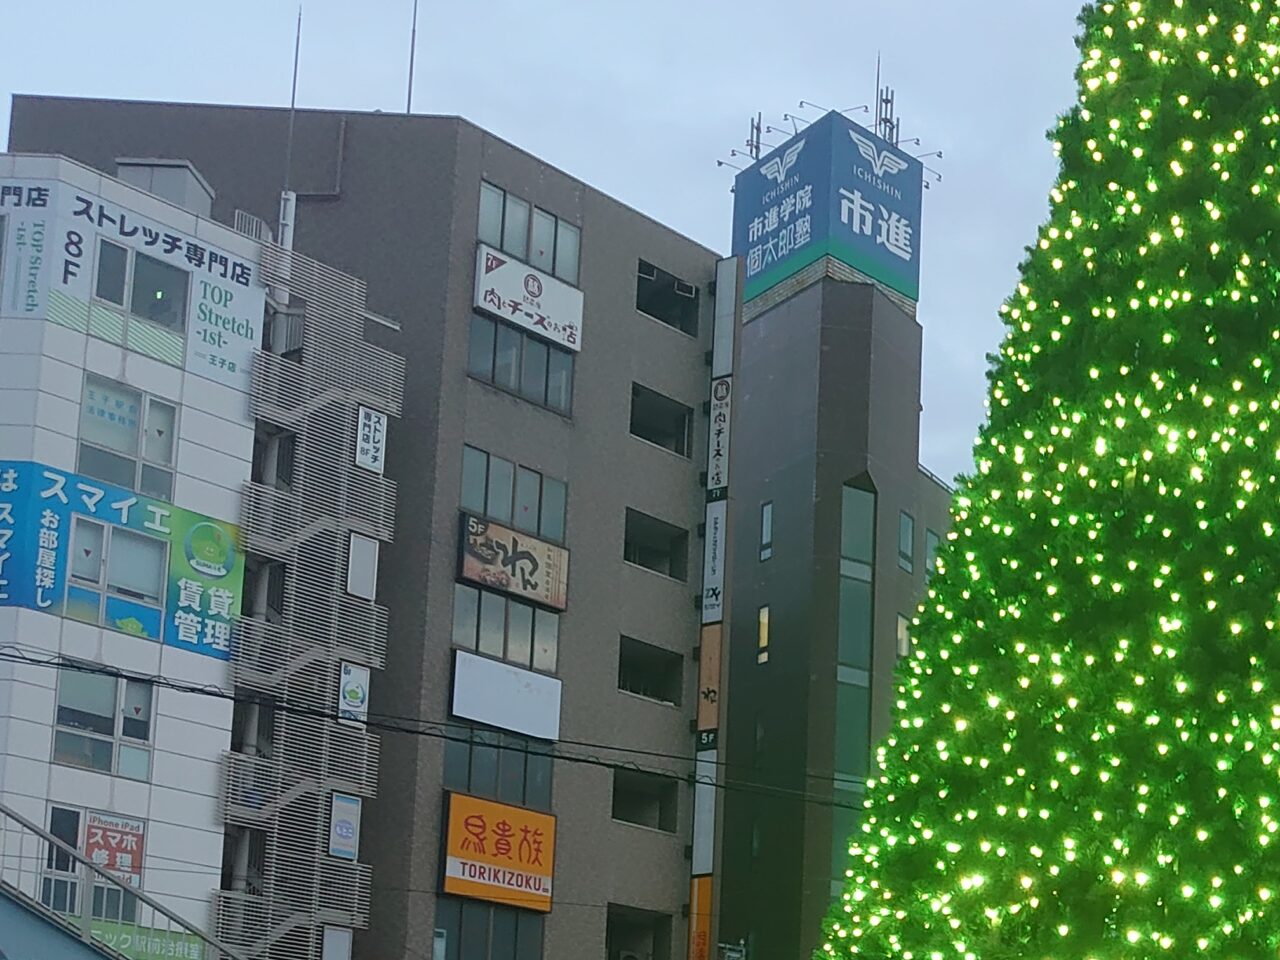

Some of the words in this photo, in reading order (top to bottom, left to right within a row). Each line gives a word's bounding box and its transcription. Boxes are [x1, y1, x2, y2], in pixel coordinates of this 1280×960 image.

[762, 173, 800, 205] ICHISHIN
[853, 165, 902, 200] ICHISHIN
[748, 185, 813, 243] 市進学院
[839, 187, 913, 261] 市進
[62, 230, 84, 285] 8F
[72, 195, 253, 287] ストレッチ専門店
[746, 214, 811, 278] 個太郎塾
[199, 279, 234, 308] TOP
[197, 302, 255, 341] Stretch
[208, 354, 237, 373] 王子店
[371, 415, 382, 464] ストレッチ
[40, 470, 172, 535] スマイエ
[468, 517, 486, 535] 5F
[35, 508, 60, 609] お部屋探し
[178, 578, 234, 619] 賃貸
[174, 610, 231, 652] 管理
[701, 732, 715, 743] 5F
[89, 816, 120, 829] iPhone
[120, 823, 141, 833] iPad
[89, 828, 138, 850] スマホ
[461, 814, 545, 868] 鳥貴族
[92, 848, 133, 872] 修理
[460, 861, 542, 892] TORIKIZOKU
